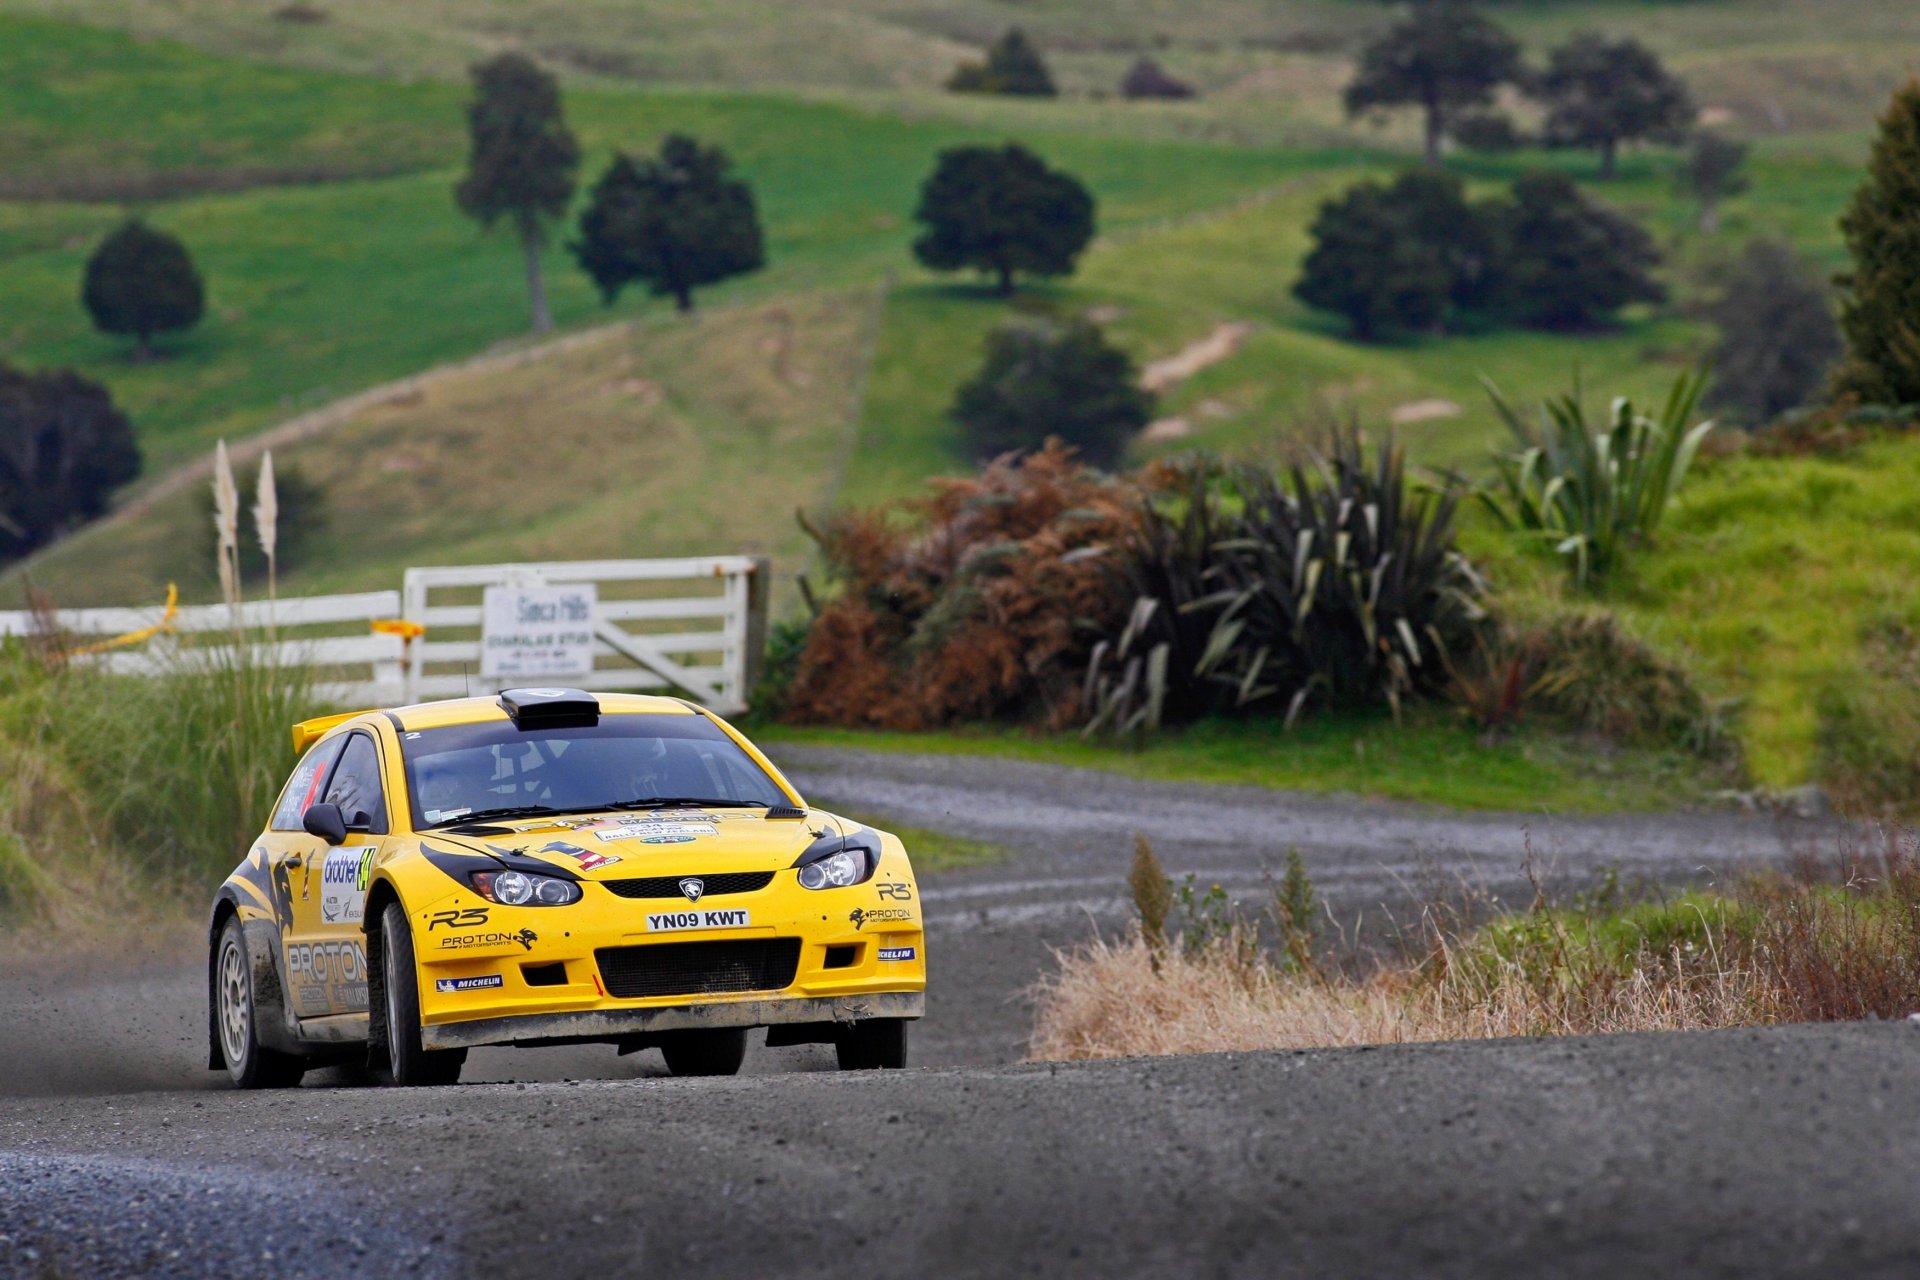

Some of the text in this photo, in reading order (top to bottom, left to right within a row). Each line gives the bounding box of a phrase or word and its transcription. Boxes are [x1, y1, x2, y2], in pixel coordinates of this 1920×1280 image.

[325, 855, 358, 884] brother
[357, 848, 376, 891] 34
[876, 883, 911, 900] R3
[428, 907, 490, 931] R3
[648, 910, 746, 930] YN09 KWT
[869, 909, 910, 918] PROTON
[442, 932, 512, 946] PROTON
[462, 941, 512, 949] MOTORSPORTS
[288, 941, 368, 984] PROTON
[457, 977, 500, 988] MICHELIN
